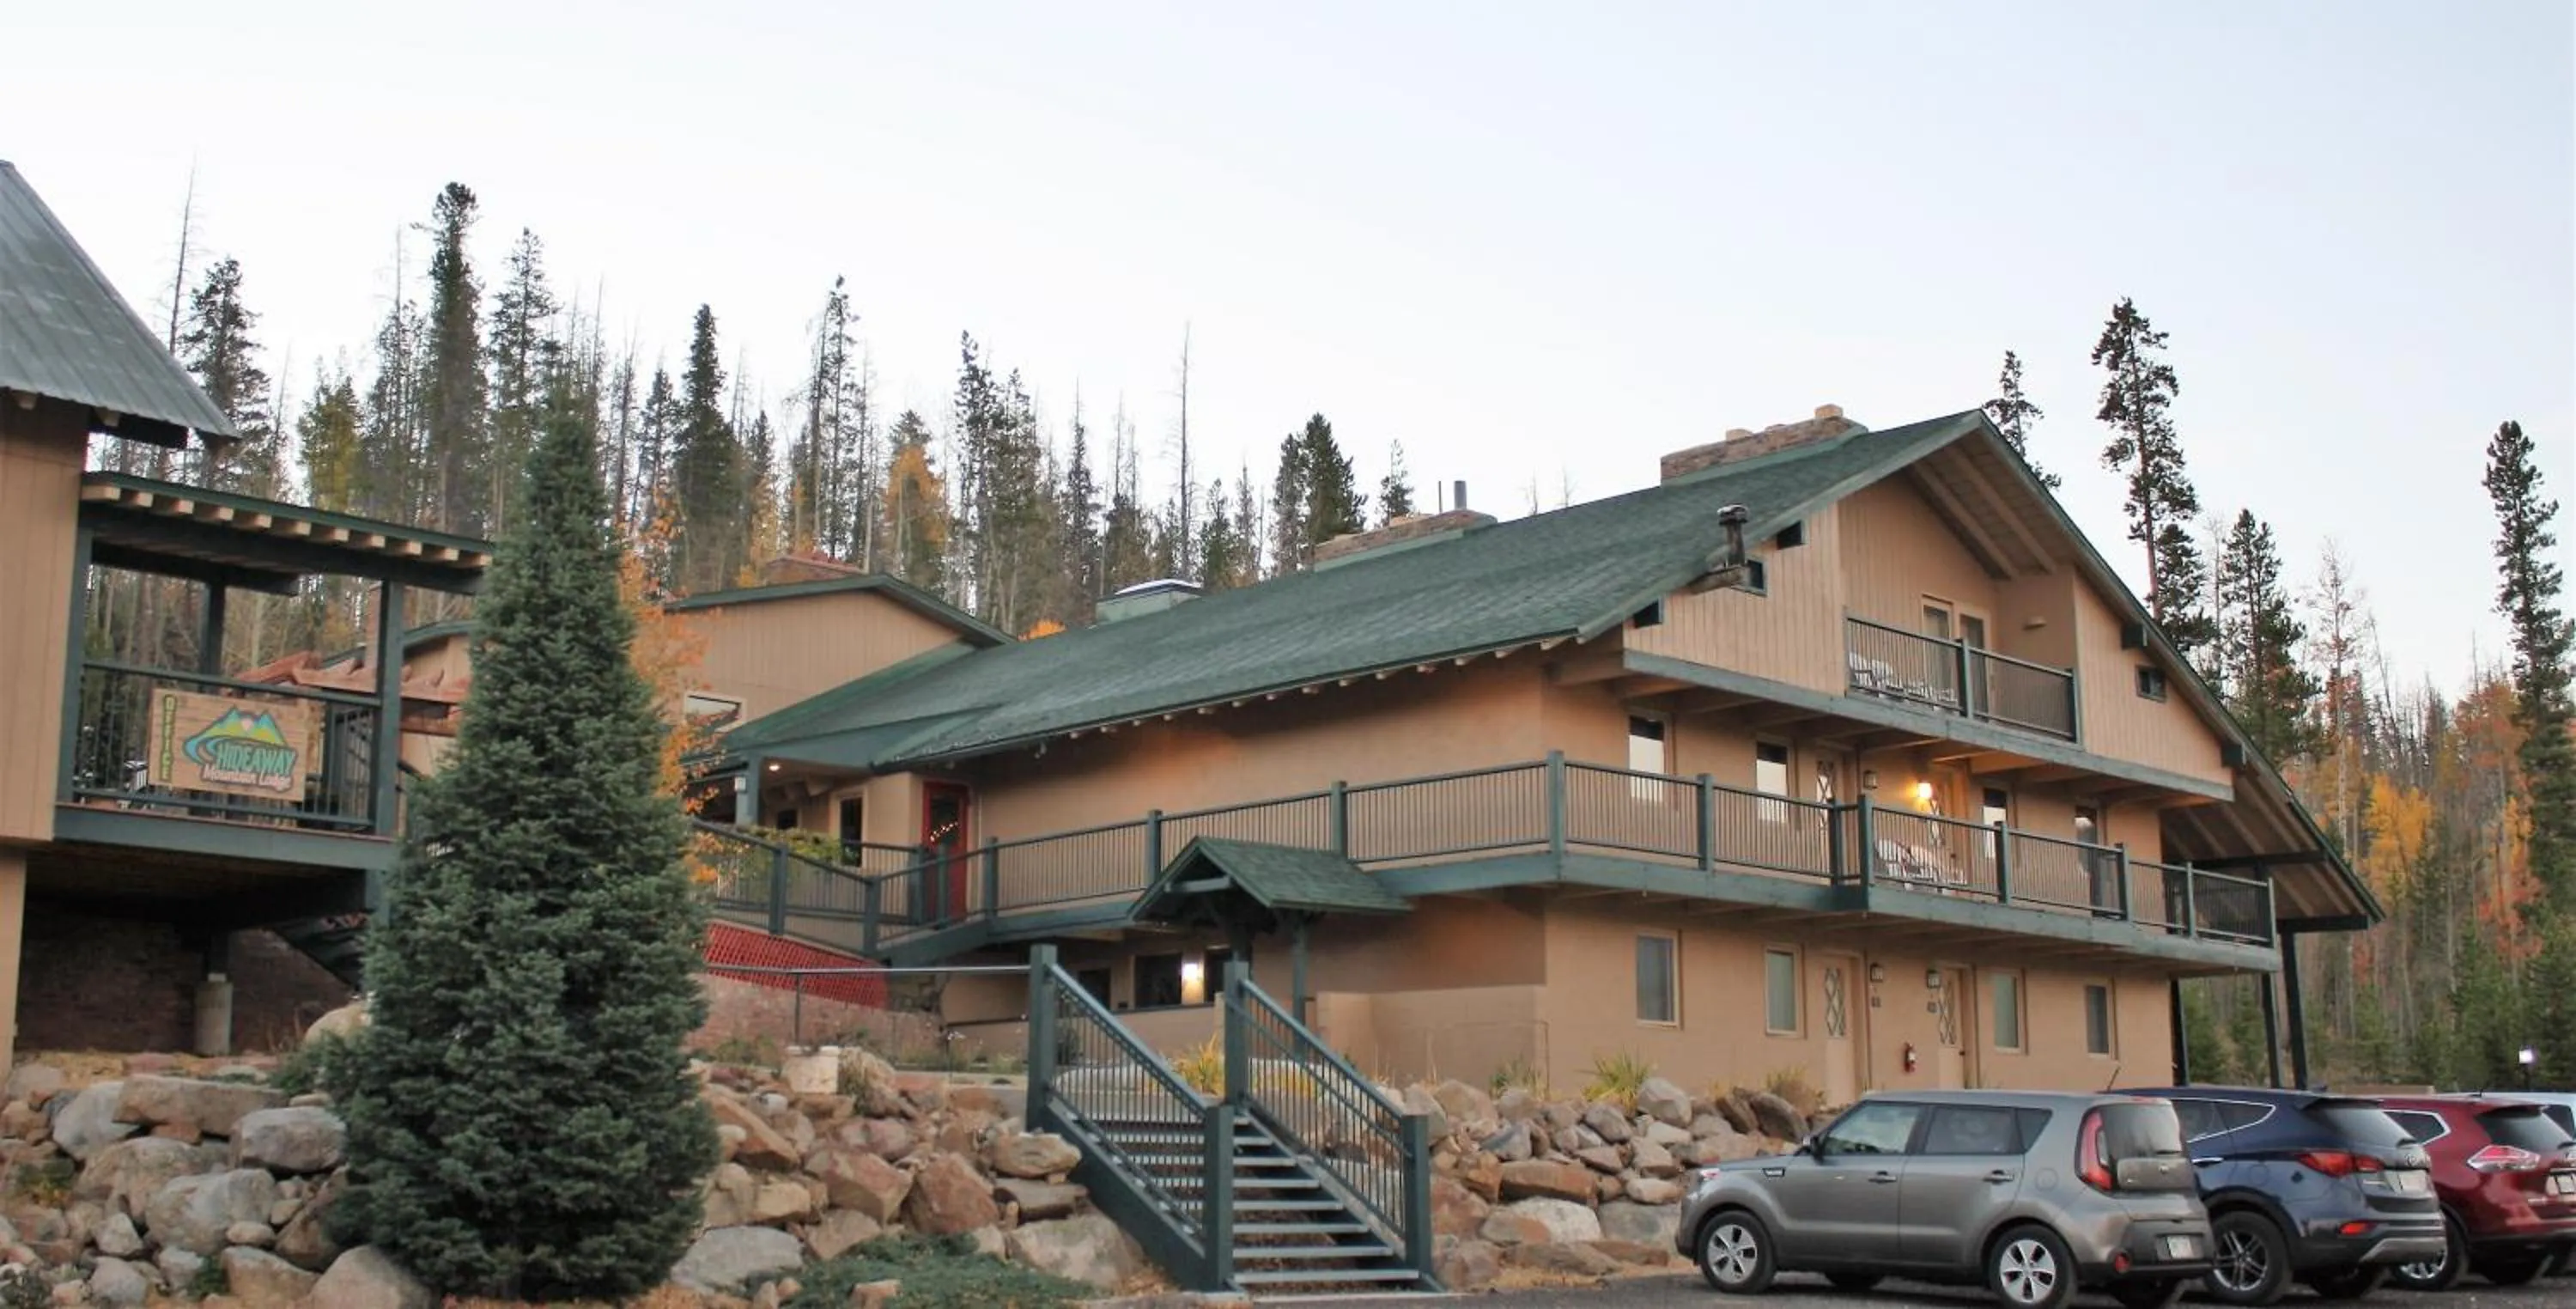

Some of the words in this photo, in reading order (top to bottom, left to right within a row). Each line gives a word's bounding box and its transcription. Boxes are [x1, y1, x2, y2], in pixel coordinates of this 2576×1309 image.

[216, 740, 296, 777] HIDEAWAY
[202, 762, 257, 784] Mountain
[258, 770, 292, 790] Lodge
